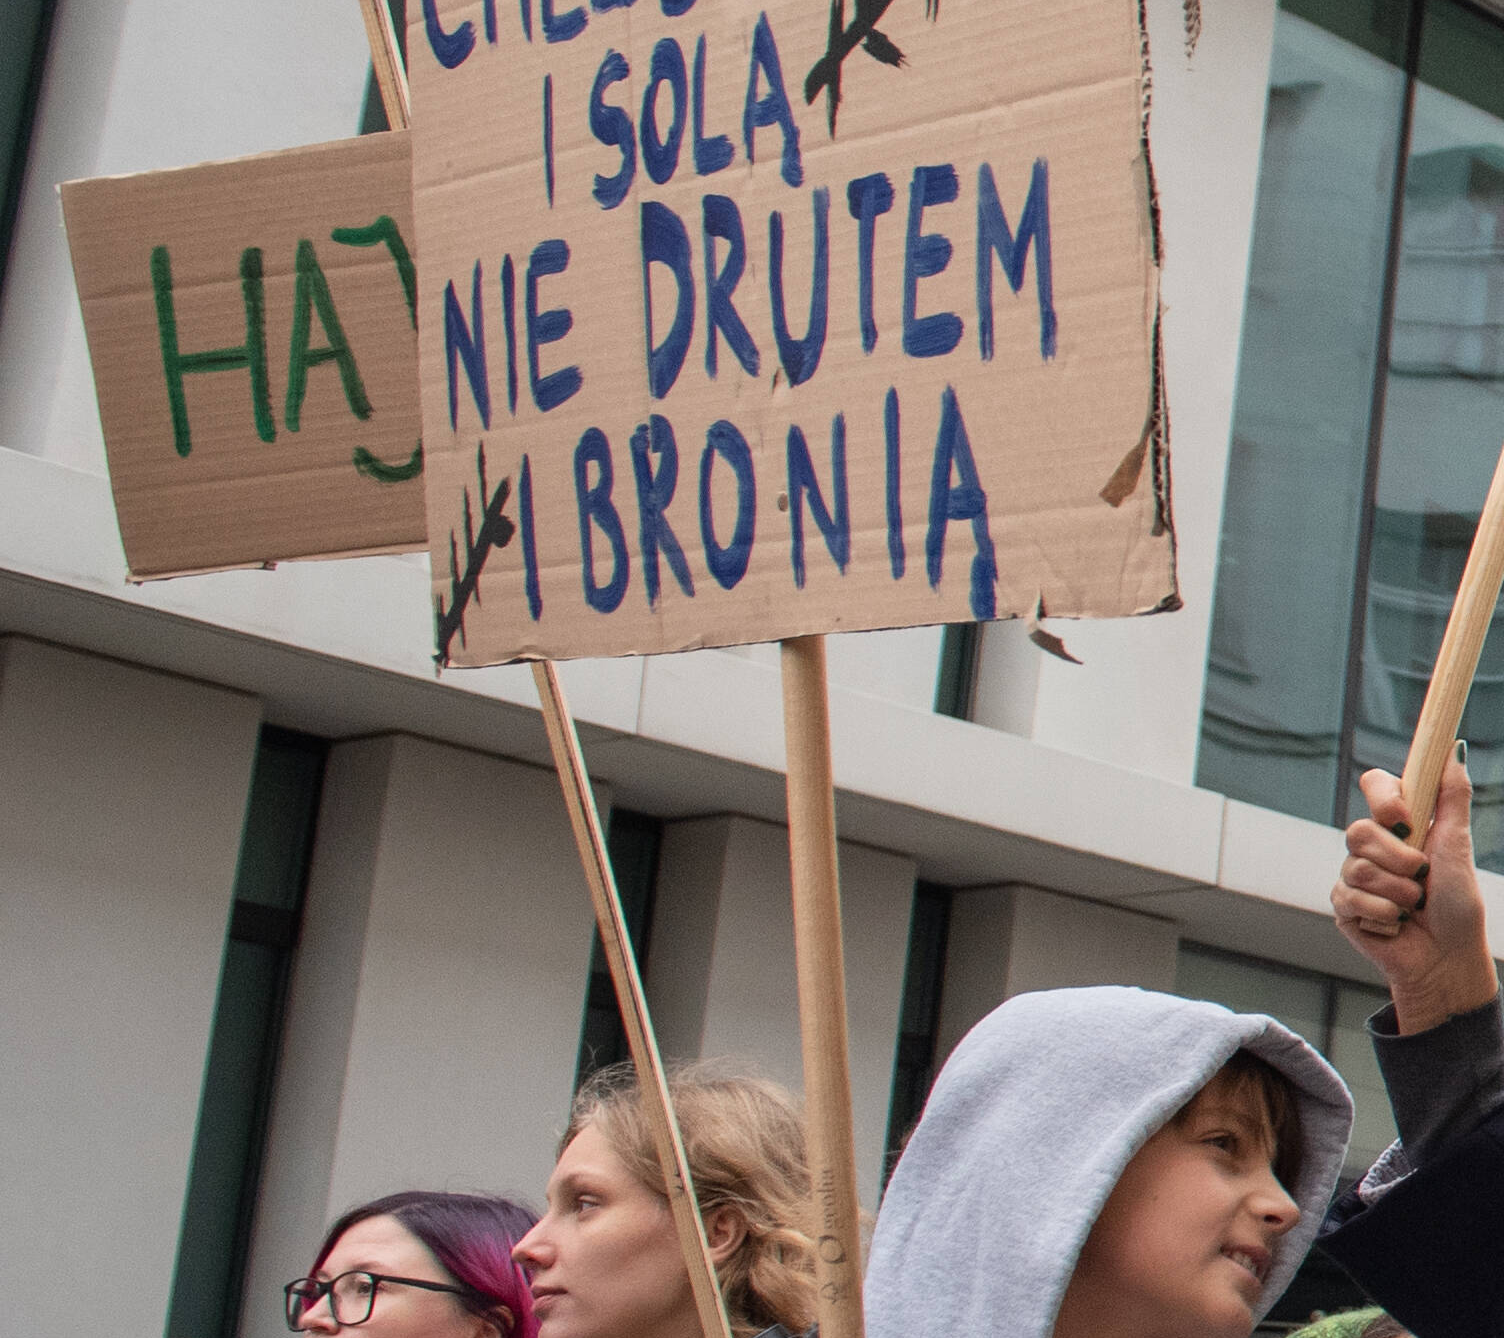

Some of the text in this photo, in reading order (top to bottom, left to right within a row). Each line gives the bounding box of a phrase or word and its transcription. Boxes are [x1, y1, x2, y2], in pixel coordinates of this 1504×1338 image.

[543, 73, 556, 209] I
[444, 157, 1058, 433] NIE DRUTEM
[519, 453, 544, 621] I
